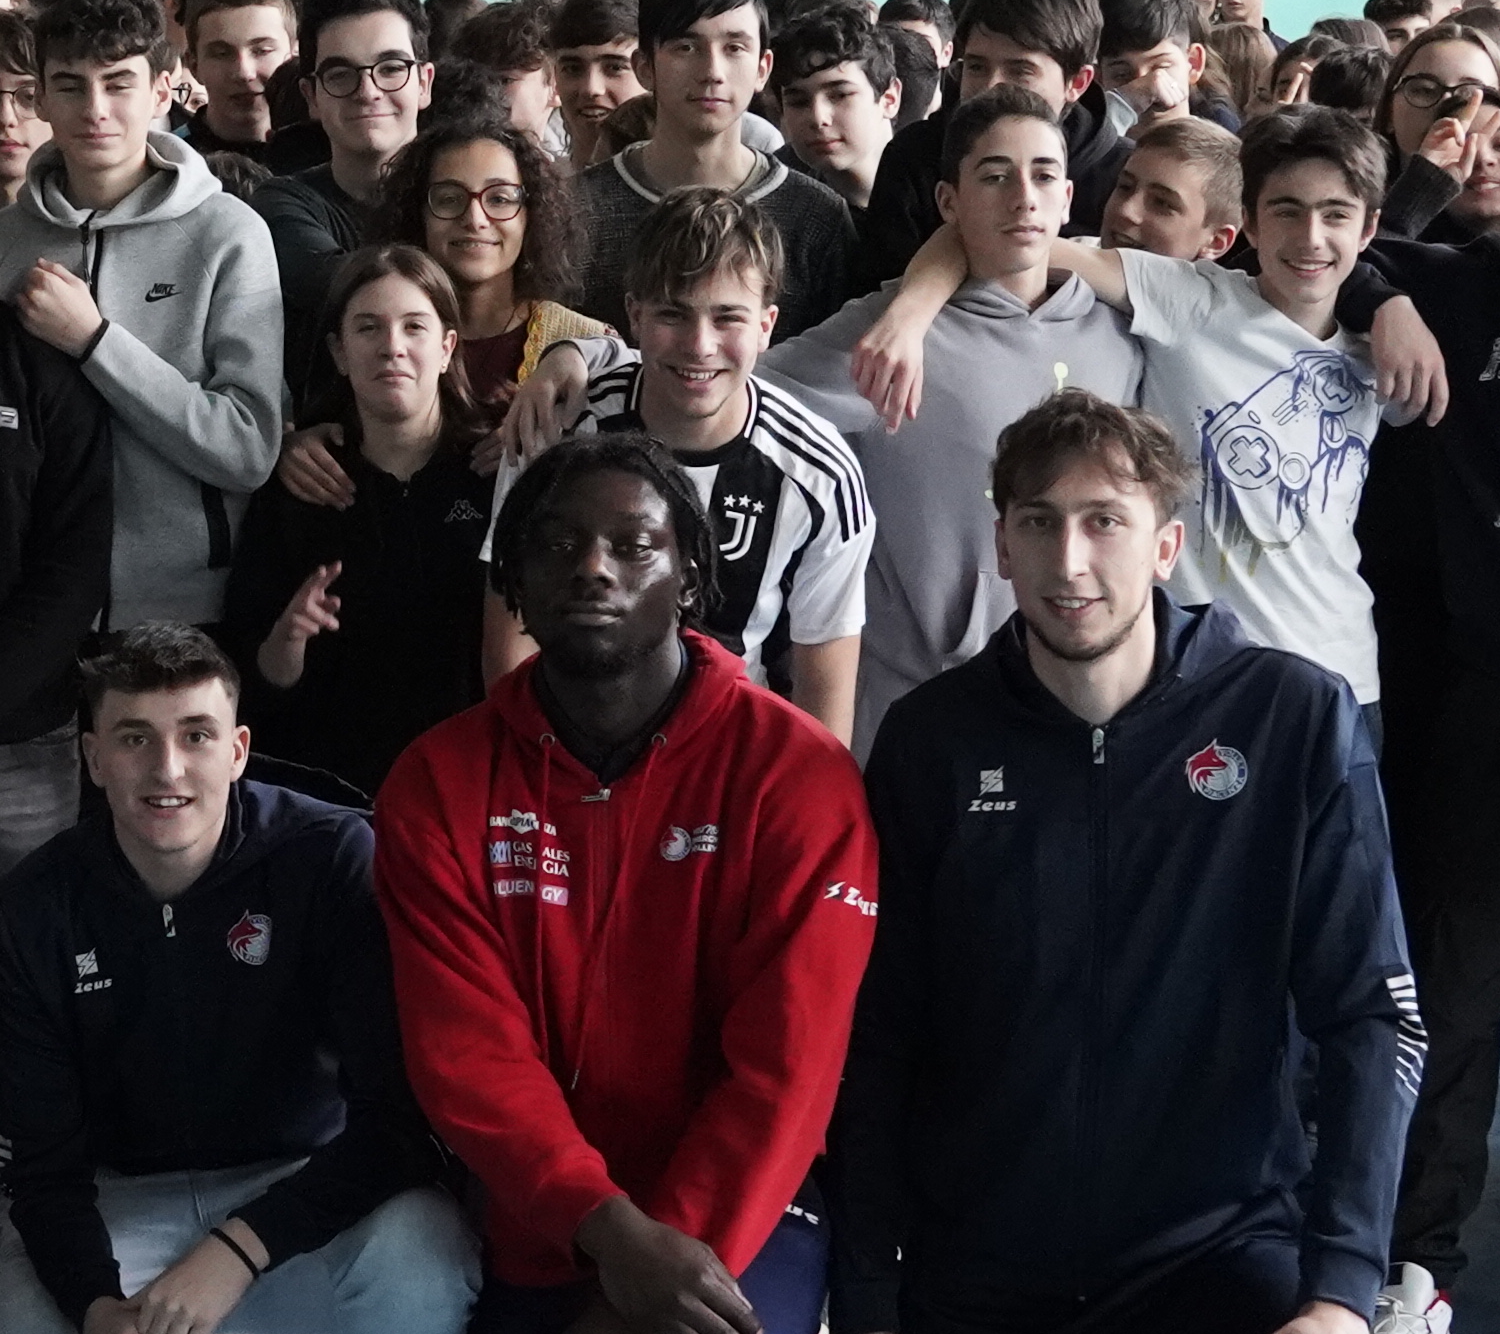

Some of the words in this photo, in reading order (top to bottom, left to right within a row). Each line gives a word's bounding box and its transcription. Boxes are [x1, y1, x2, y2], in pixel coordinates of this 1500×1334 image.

[967, 799, 1018, 813] Zeus
[541, 846, 571, 864] ALES
[73, 978, 113, 994] Zeus
